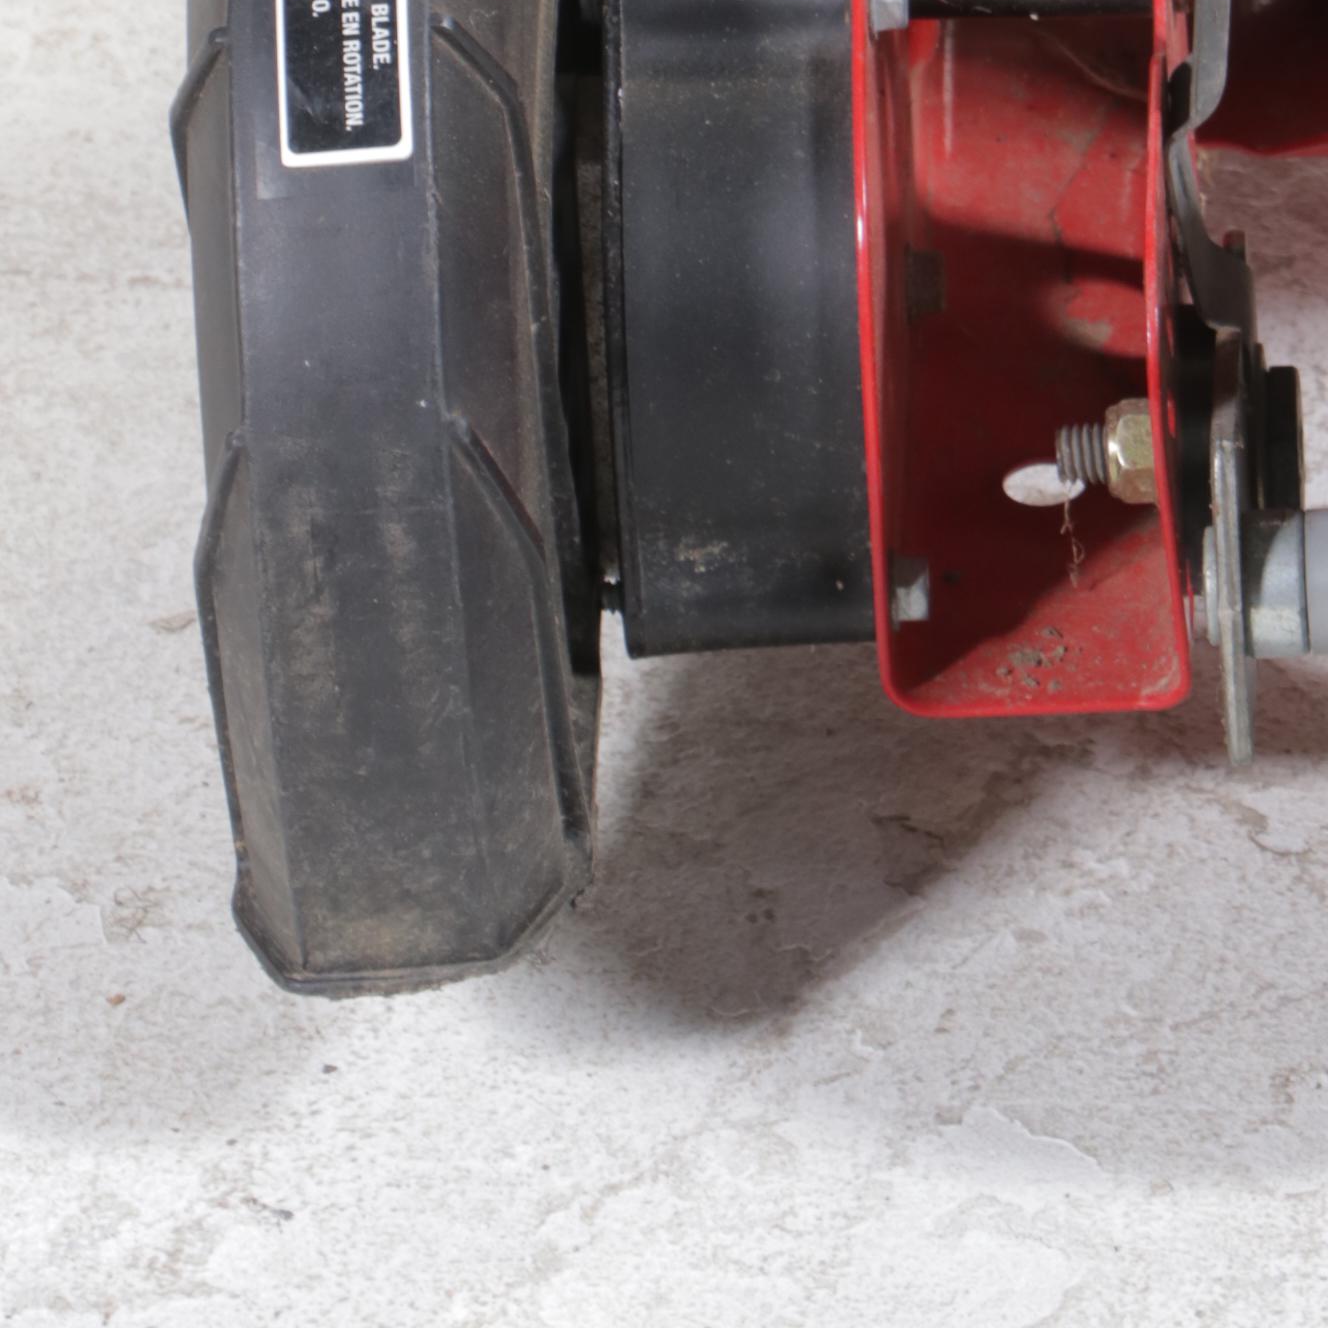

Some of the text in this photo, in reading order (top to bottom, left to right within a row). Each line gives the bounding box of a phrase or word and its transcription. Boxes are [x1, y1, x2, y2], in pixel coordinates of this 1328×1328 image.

[342, 14, 360, 35] EN
[371, 3, 391, 70] BLADE.
[343, 40, 363, 132] ROTATION.
